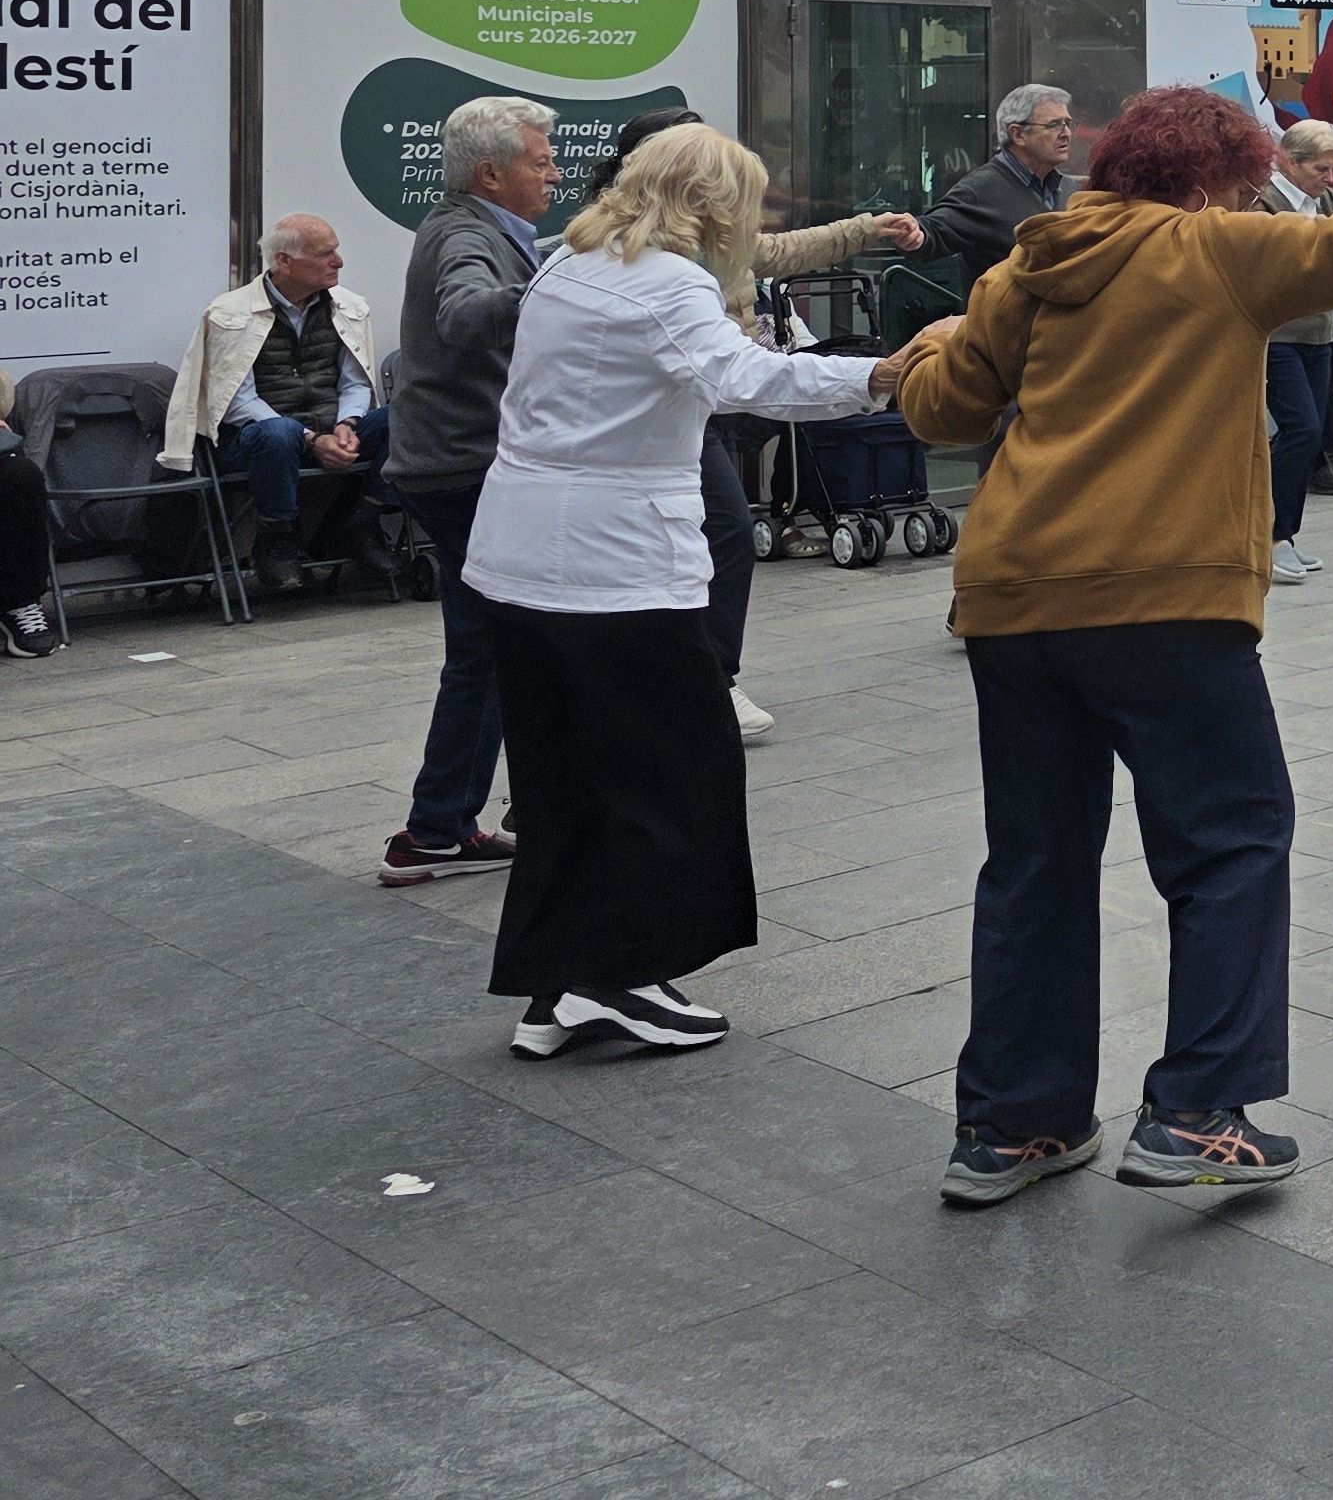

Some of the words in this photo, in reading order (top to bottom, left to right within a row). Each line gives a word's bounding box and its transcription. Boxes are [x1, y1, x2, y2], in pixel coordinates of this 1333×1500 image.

[478, 5, 593, 26] Municipals
[478, 29, 524, 43] curs
[529, 28, 637, 45] 2026-2027
[401, 120, 441, 137] Del
[557, 119, 612, 140] maig
[25, 138, 44, 155] el
[52, 137, 151, 158] genocidi
[400, 143, 443, 159] 202
[564, 141, 618, 157] inclo
[6, 160, 74, 176] duent
[83, 164, 94, 175] a
[102, 161, 169, 175] terme
[10, 179, 144, 201] Cisjordània,
[56, 199, 187, 218] humanitari.
[61, 248, 112, 265] amb
[119, 247, 138, 263] el
[16, 291, 108, 310] localitat
